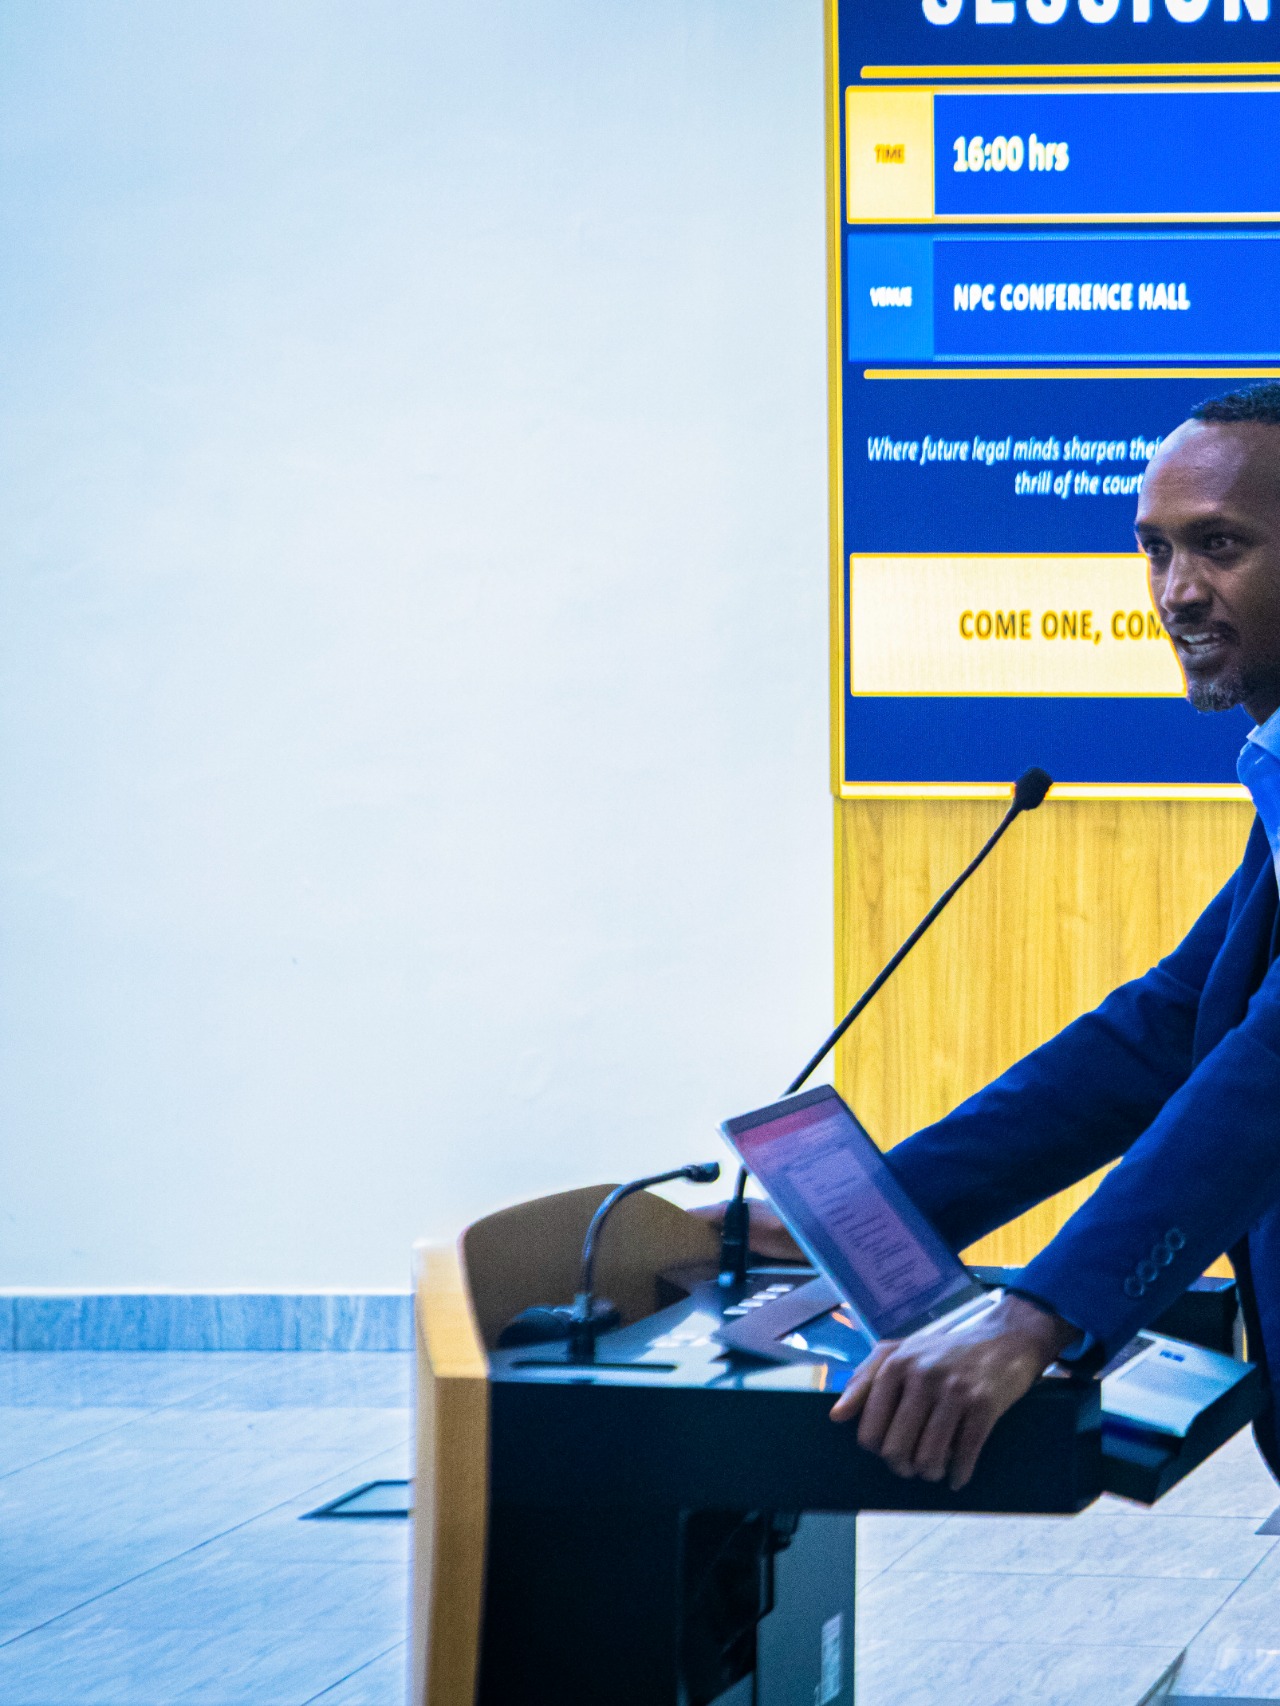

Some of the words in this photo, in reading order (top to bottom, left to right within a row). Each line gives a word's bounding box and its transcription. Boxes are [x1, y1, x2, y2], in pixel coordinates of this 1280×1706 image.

[874, 144, 905, 164] TIME
[953, 136, 1024, 172] 16:00
[1029, 133, 1069, 171] hrs
[870, 287, 912, 306] VENUE
[954, 284, 995, 311] NPC
[1000, 283, 1133, 311] CONFERENCE
[1138, 283, 1190, 310] HALL
[868, 437, 918, 461] Where
[920, 436, 968, 465] future
[972, 437, 1010, 465] legal
[1013, 438, 1059, 460] minds
[1064, 437, 1125, 463] sharpen
[1130, 436, 1161, 461] thei
[1015, 471, 1051, 494] thrill
[1054, 471, 1072, 498] of
[1074, 471, 1099, 494] the
[959, 610, 1032, 640] COME
[1041, 610, 1102, 645] ONE,
